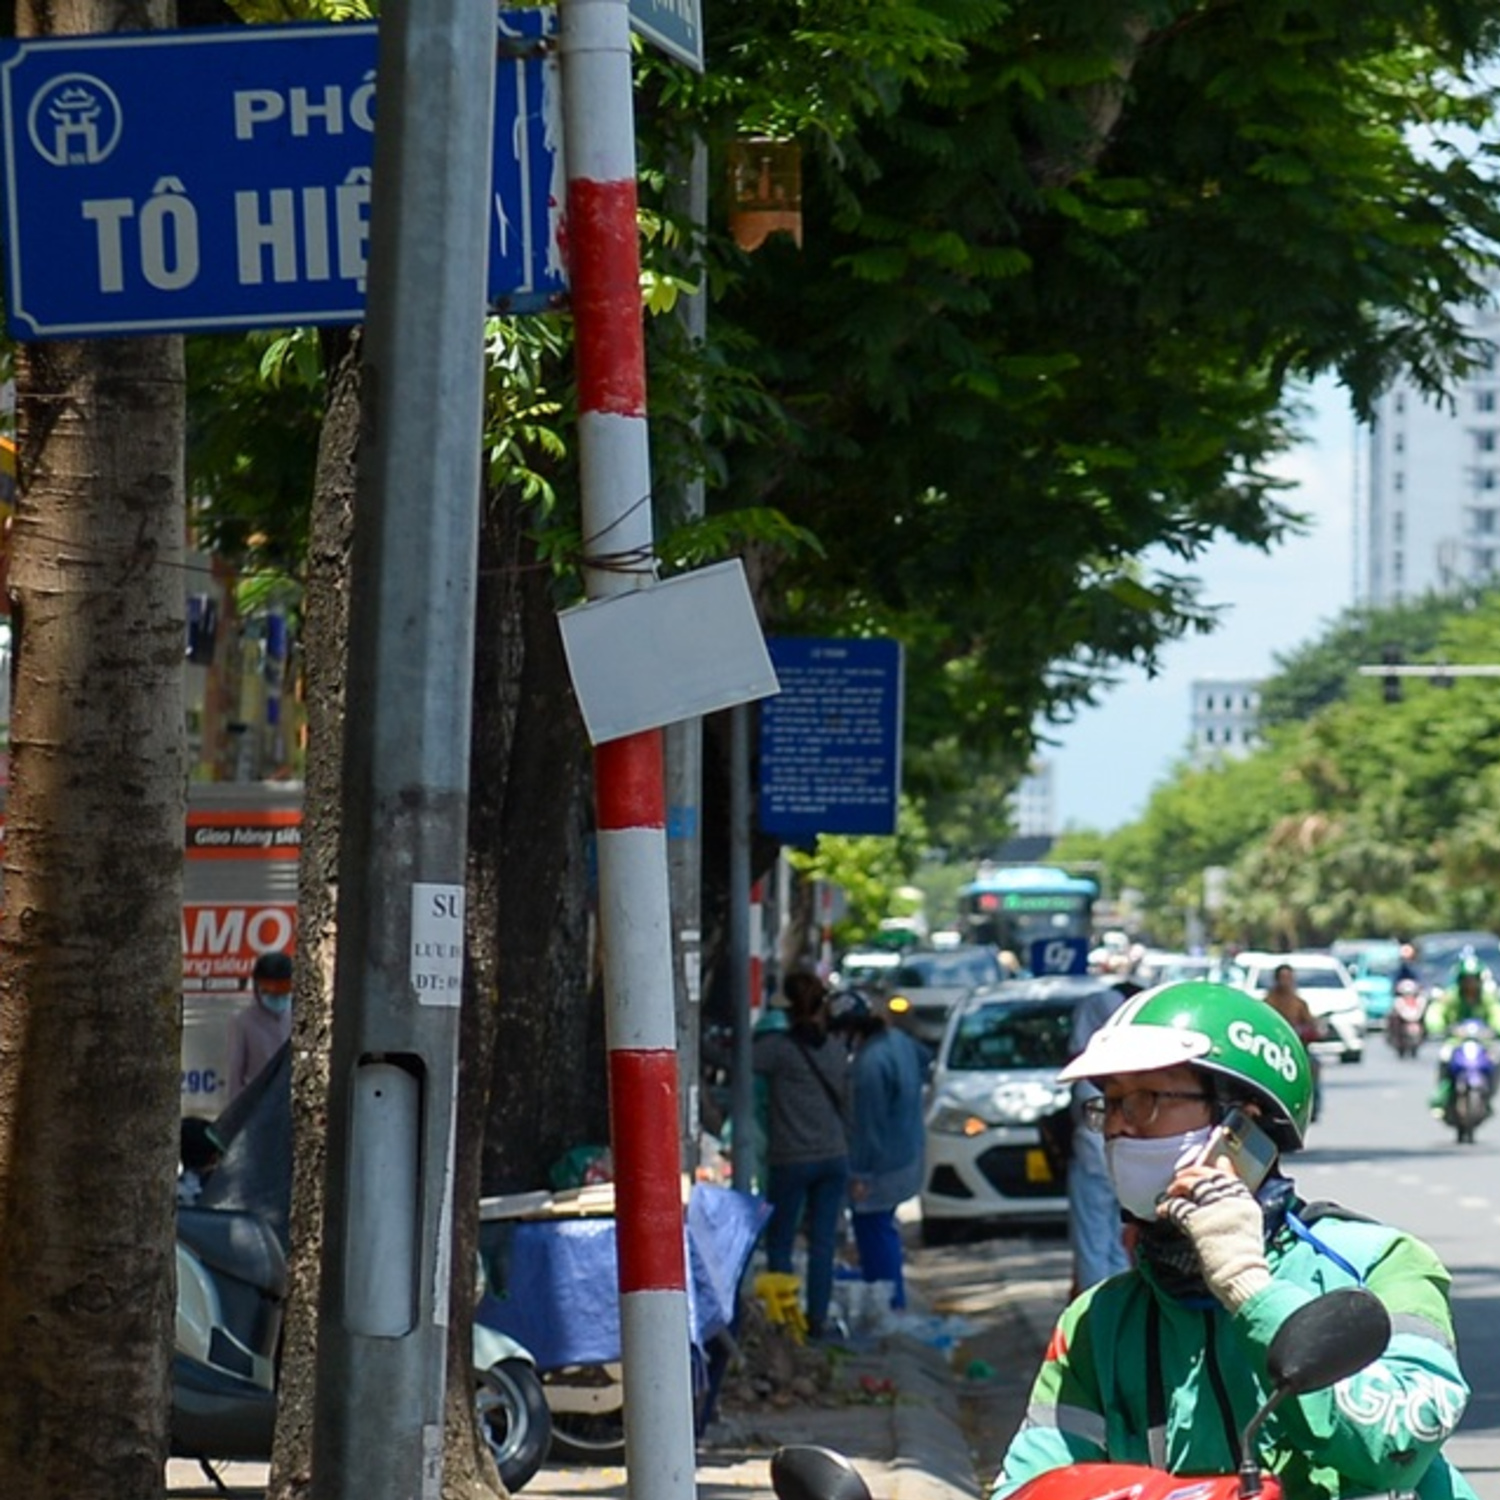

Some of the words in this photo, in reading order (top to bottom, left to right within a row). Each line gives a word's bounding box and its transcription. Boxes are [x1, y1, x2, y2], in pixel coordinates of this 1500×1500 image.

[81, 174, 200, 293] TÔ
[234, 166, 373, 293] HIỆ
[194, 827, 231, 845] Giao
[1227, 1020, 1298, 1084] Grab
